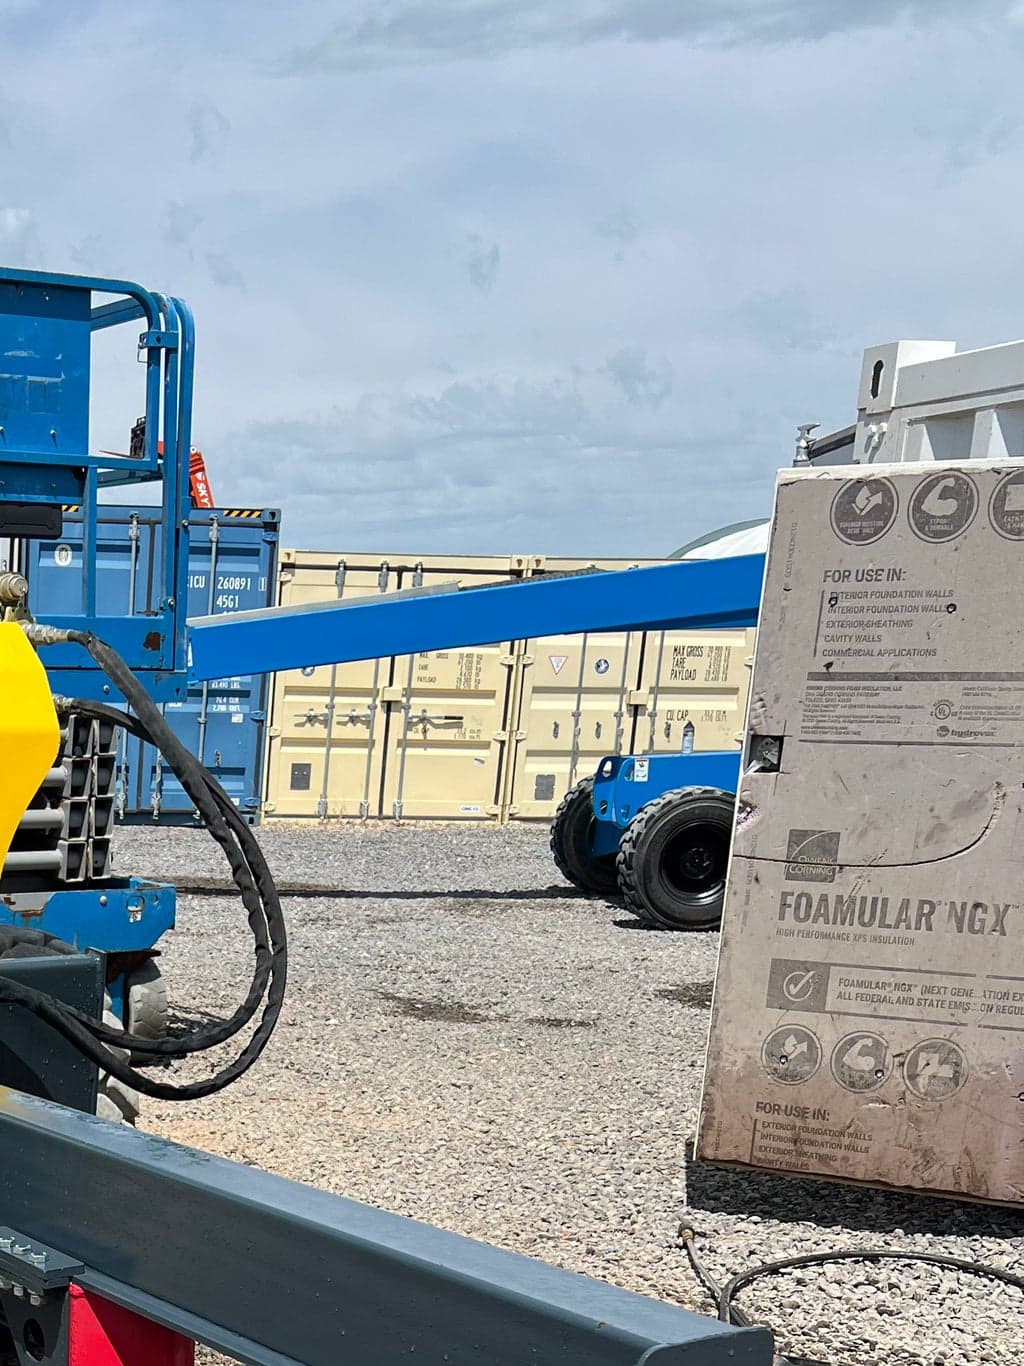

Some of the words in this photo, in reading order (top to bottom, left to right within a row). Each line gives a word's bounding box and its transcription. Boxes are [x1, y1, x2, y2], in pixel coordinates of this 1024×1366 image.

[823, 569, 852, 583] FOR
[855, 568, 884, 582] USE
[886, 567, 907, 582] IN:
[187, 576, 206, 588] ICU
[217, 576, 251, 591] 260891
[870, 590, 925, 599] FOUNDATION
[926, 589, 955, 598] WALLS
[216, 595, 239, 608] 45G1
[866, 604, 920, 614] FOUNDATION
[921, 604, 949, 613] WALL
[826, 620, 864, 629] EXTERIOR
[865, 619, 914, 629] SHEATHING
[824, 634, 854, 643] CAVITY
[855, 634, 883, 643] WALLS
[686, 645, 704, 658] GROSS
[822, 648, 876, 657] COMMERCIAL
[877, 648, 938, 657] APPLICATIONS
[672, 657, 686, 669] TARE
[670, 669, 697, 681] PAYLOAD
[676, 709, 689, 721] CAP
[789, 864, 833, 876] CORNING
[776, 927, 795, 938] HIGH
[797, 929, 851, 942] PERFORMANCE
[852, 934, 868, 943] XPS
[869, 934, 916, 946] INSULATION
[951, 987, 1010, 1001] GENETION
[837, 991, 854, 1001] ALL
[855, 992, 894, 1004] FEDERAL
[896, 996, 915, 1007] AND
[916, 997, 946, 1009] STATE
[948, 1000, 994, 1013] EMISON
[996, 1003, 1024, 1016] REGUL
[755, 1101, 781, 1116] FOR
[784, 1105, 811, 1120] USE
[812, 1109, 830, 1122] IN:
[761, 1120, 797, 1131] EXTERIOR
[798, 1125, 846, 1138] FOUNDATION
[847, 1131, 873, 1142] WALLS
[760, 1132, 794, 1145] INTERIOR
[844, 1142, 870, 1154] WALLS
